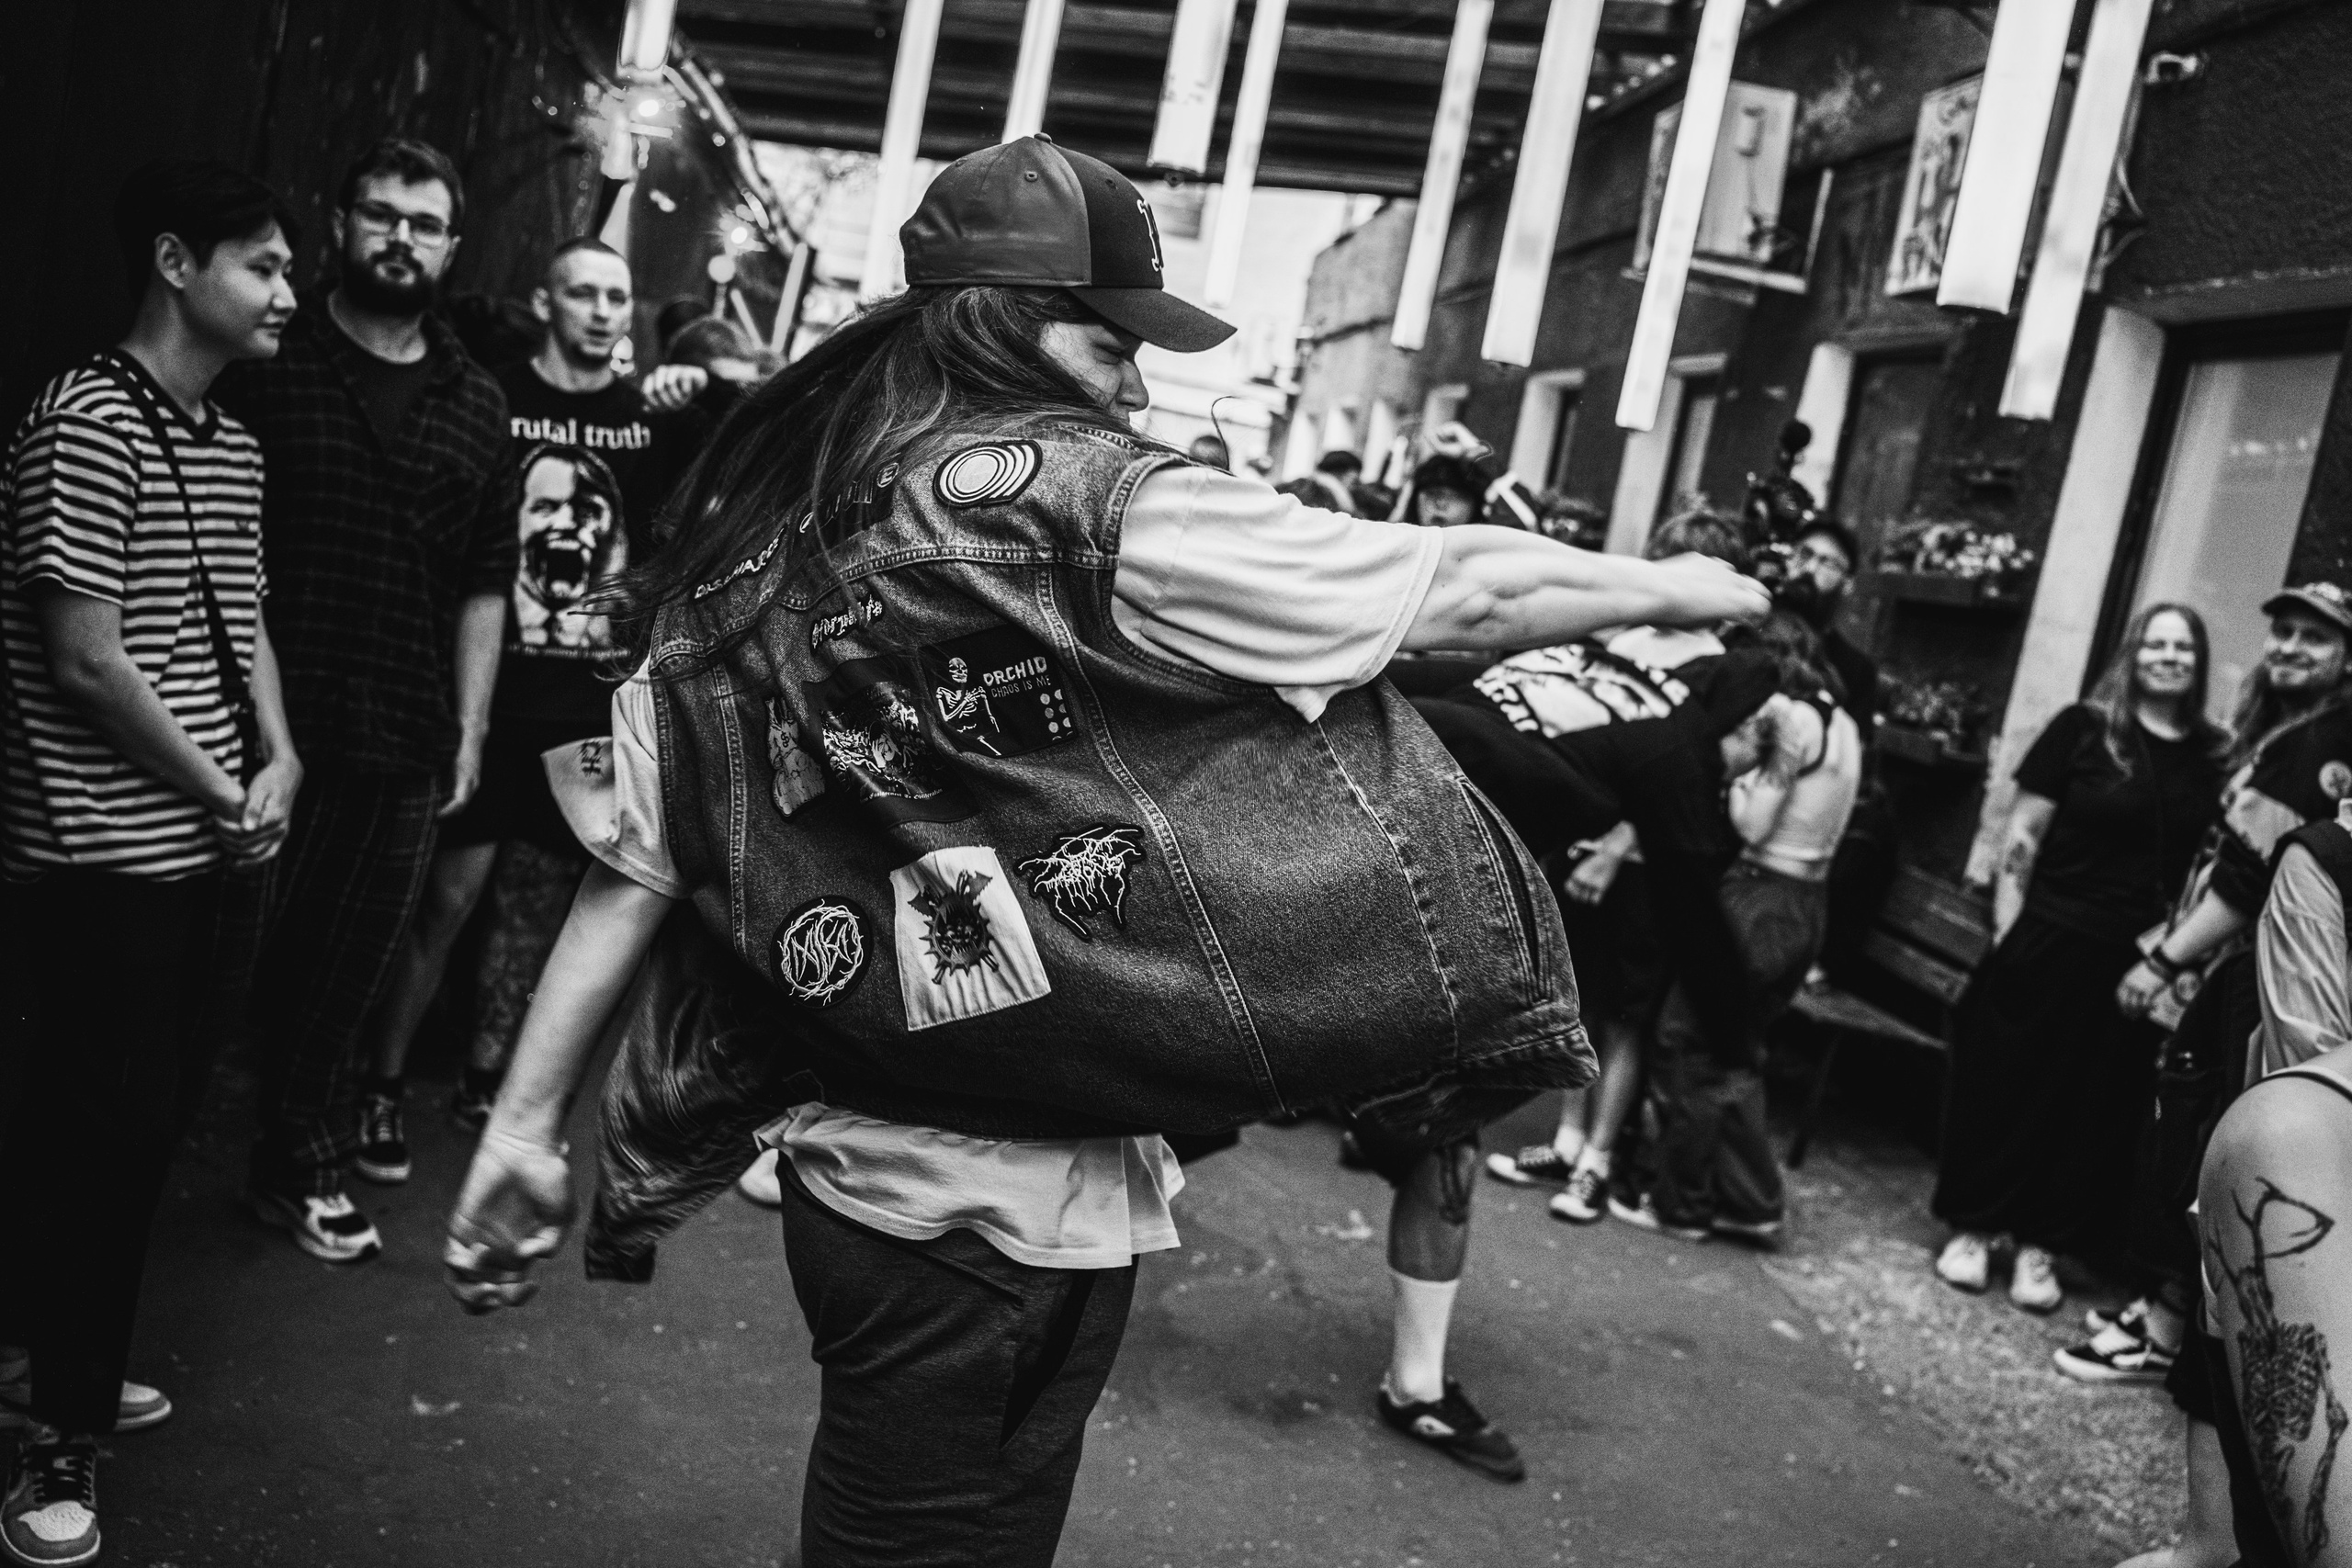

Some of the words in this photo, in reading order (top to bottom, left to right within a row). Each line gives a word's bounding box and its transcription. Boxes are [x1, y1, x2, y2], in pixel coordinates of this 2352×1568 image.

[510, 416, 577, 445] rutal
[583, 421, 650, 450] truth
[983, 656, 1047, 687] ORCHID
[991, 683, 1020, 698] CHAOS
[1023, 680, 1033, 691] IS
[1035, 674, 1051, 688] ME
